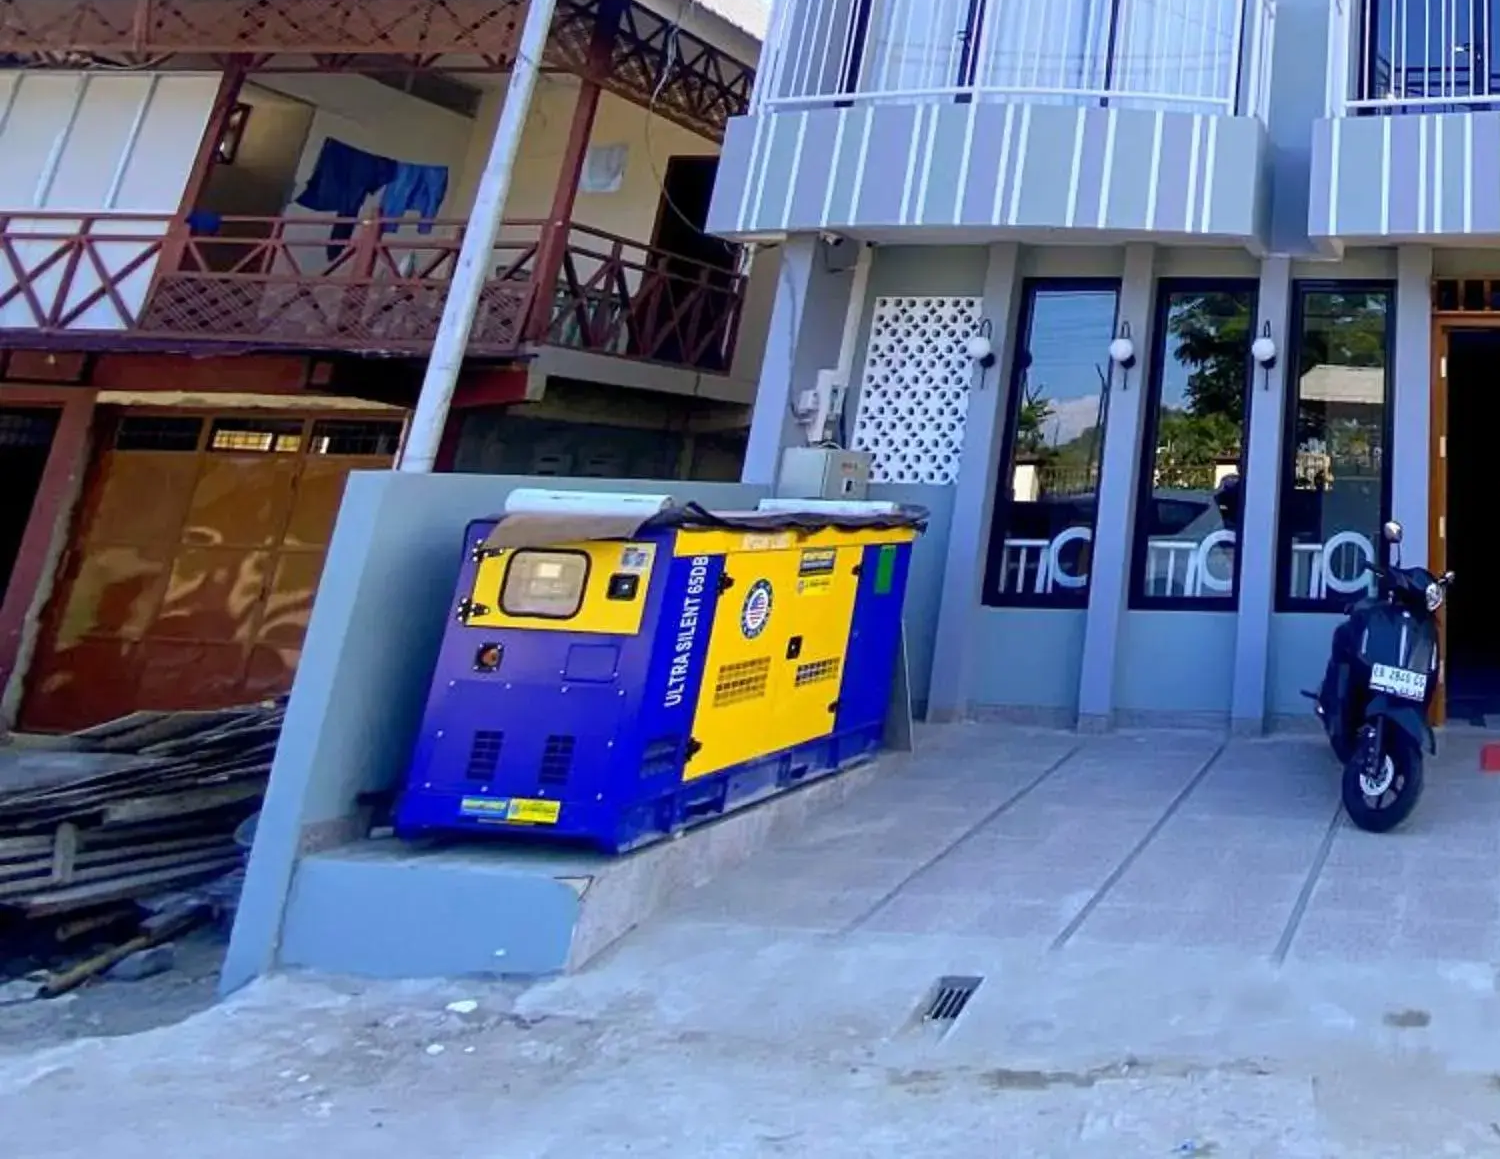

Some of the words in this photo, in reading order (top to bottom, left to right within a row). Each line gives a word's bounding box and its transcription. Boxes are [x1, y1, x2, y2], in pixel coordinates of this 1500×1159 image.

[687, 556, 709, 593] 65DB
[675, 596, 701, 652] SILENT
[664, 652, 691, 709] ULTRA
